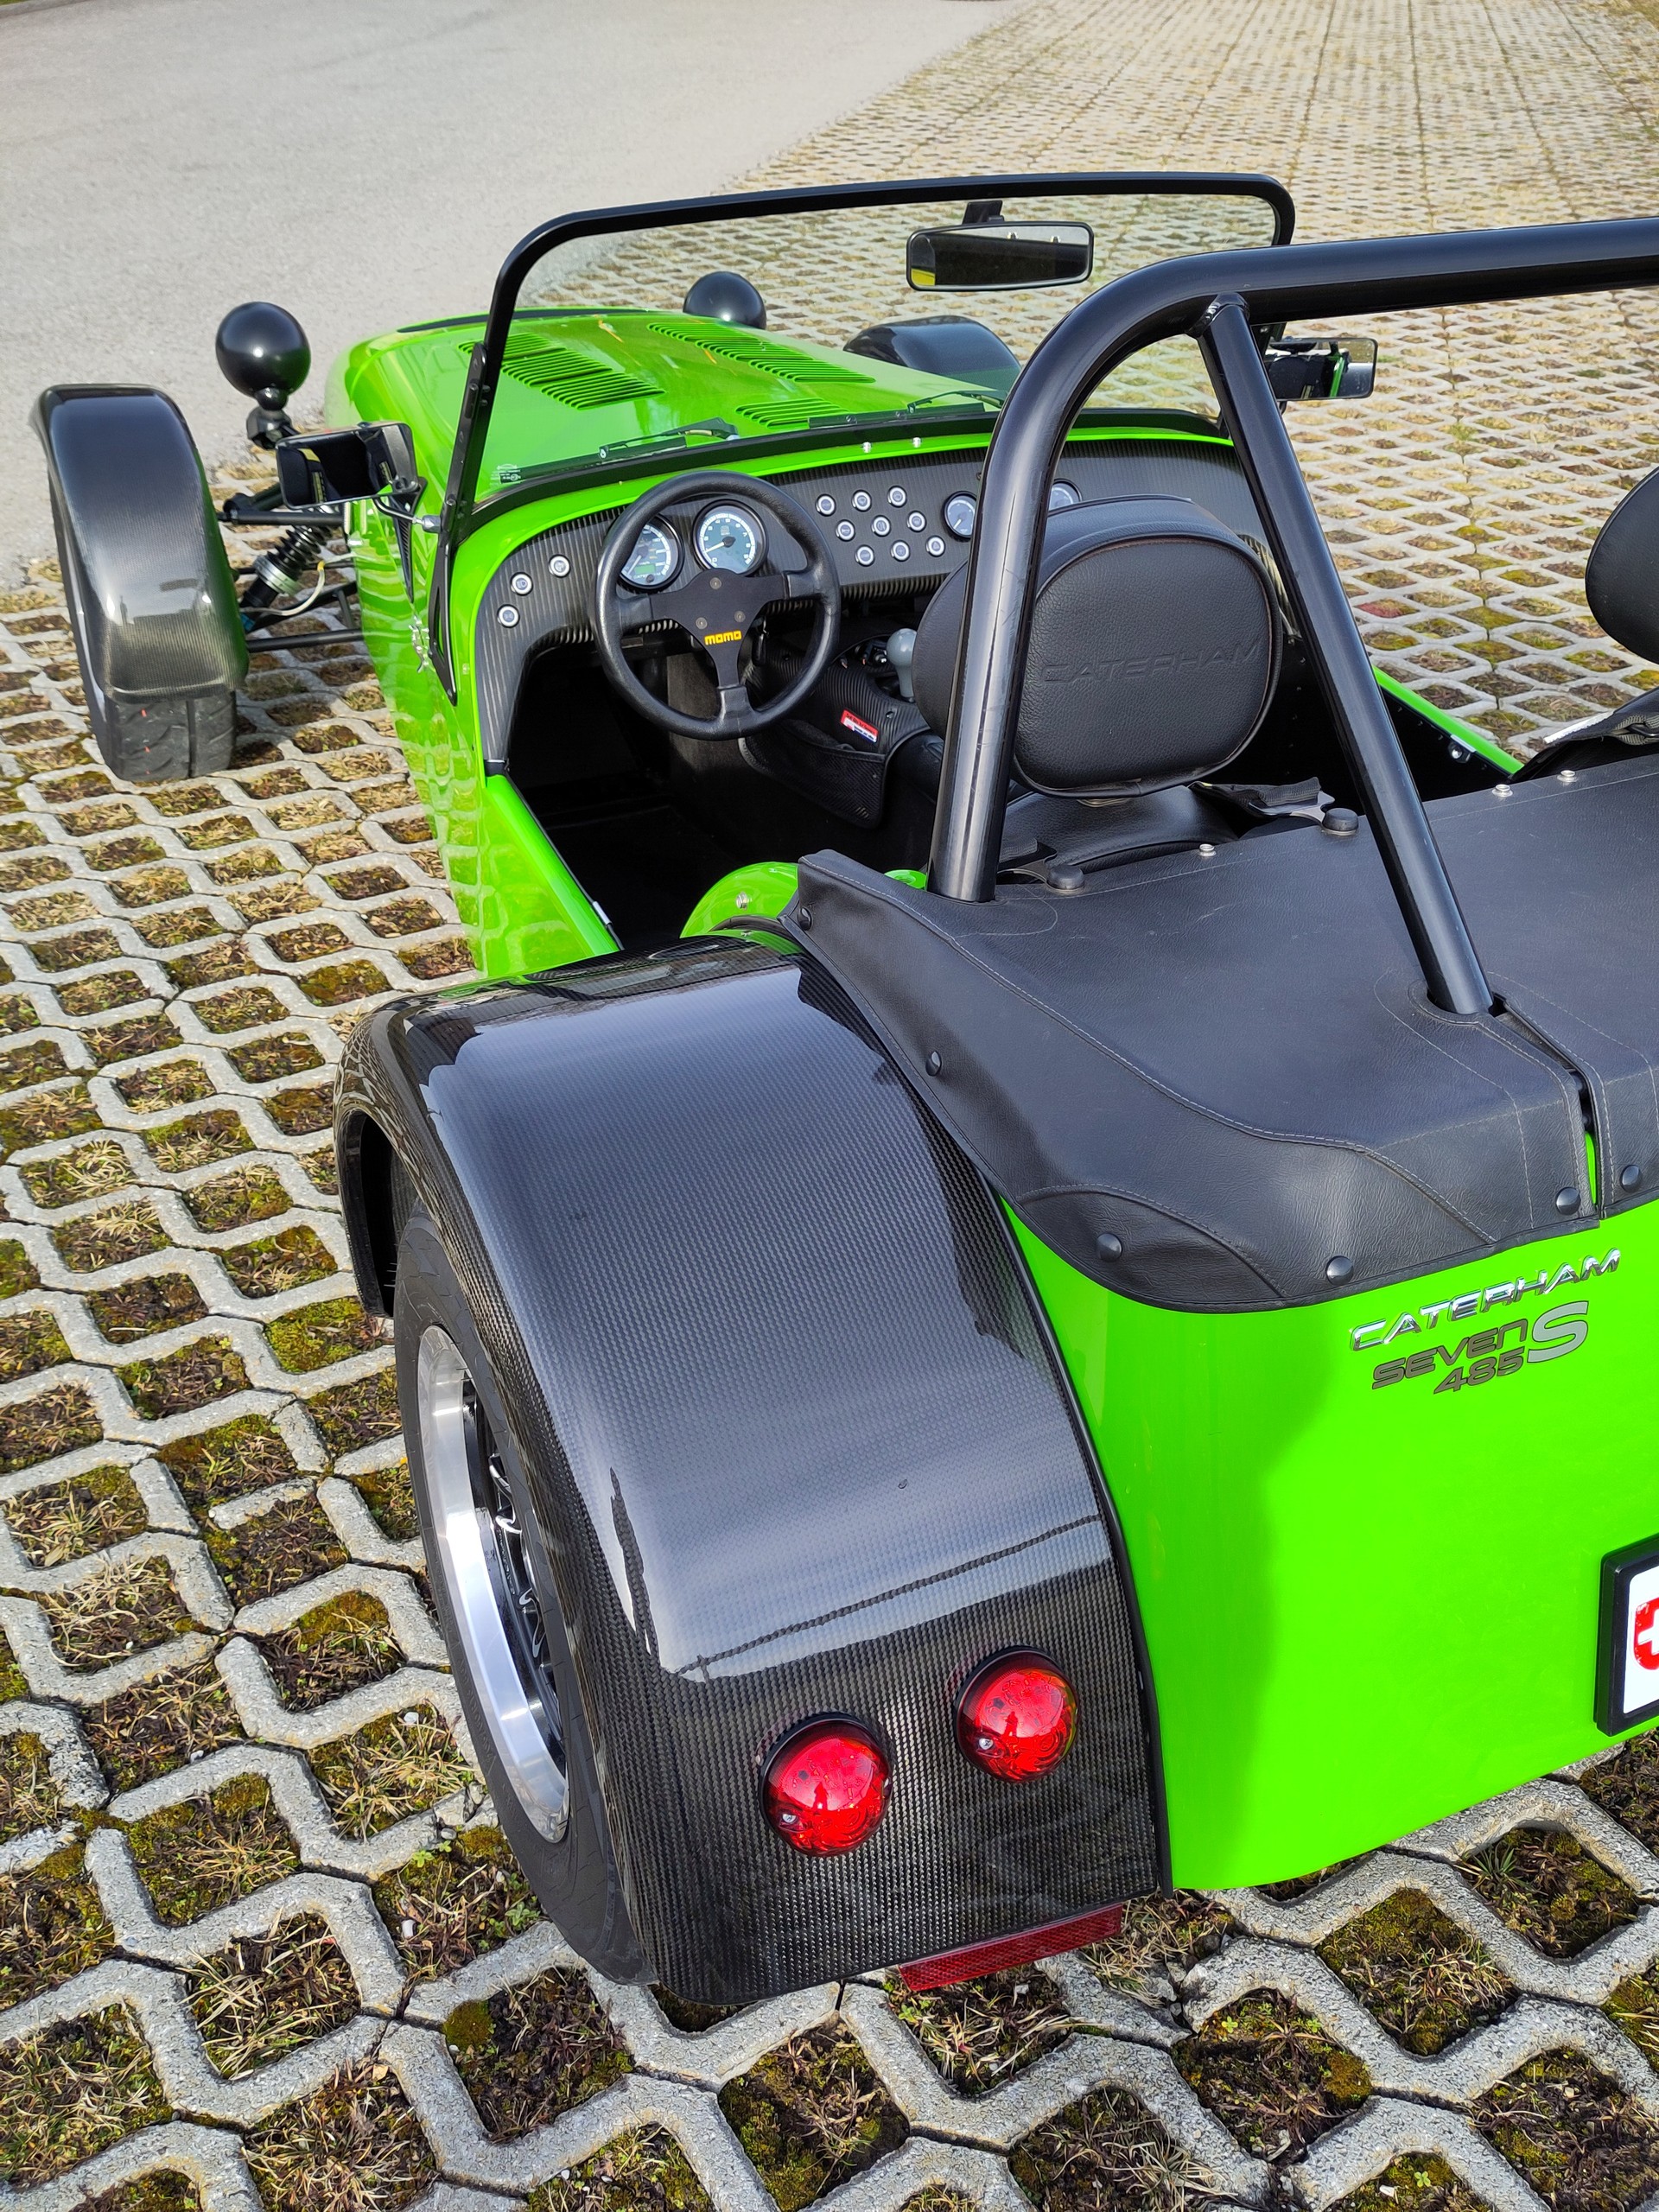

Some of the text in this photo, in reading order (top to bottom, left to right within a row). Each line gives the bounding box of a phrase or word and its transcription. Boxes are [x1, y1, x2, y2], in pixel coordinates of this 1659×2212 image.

[1040, 640, 1263, 685] CATERHAM
[1350, 1248, 1621, 1351] CATERHAM
[1371, 1300, 1590, 1390] SEVEN S
[1433, 1345, 1526, 1395] 485
